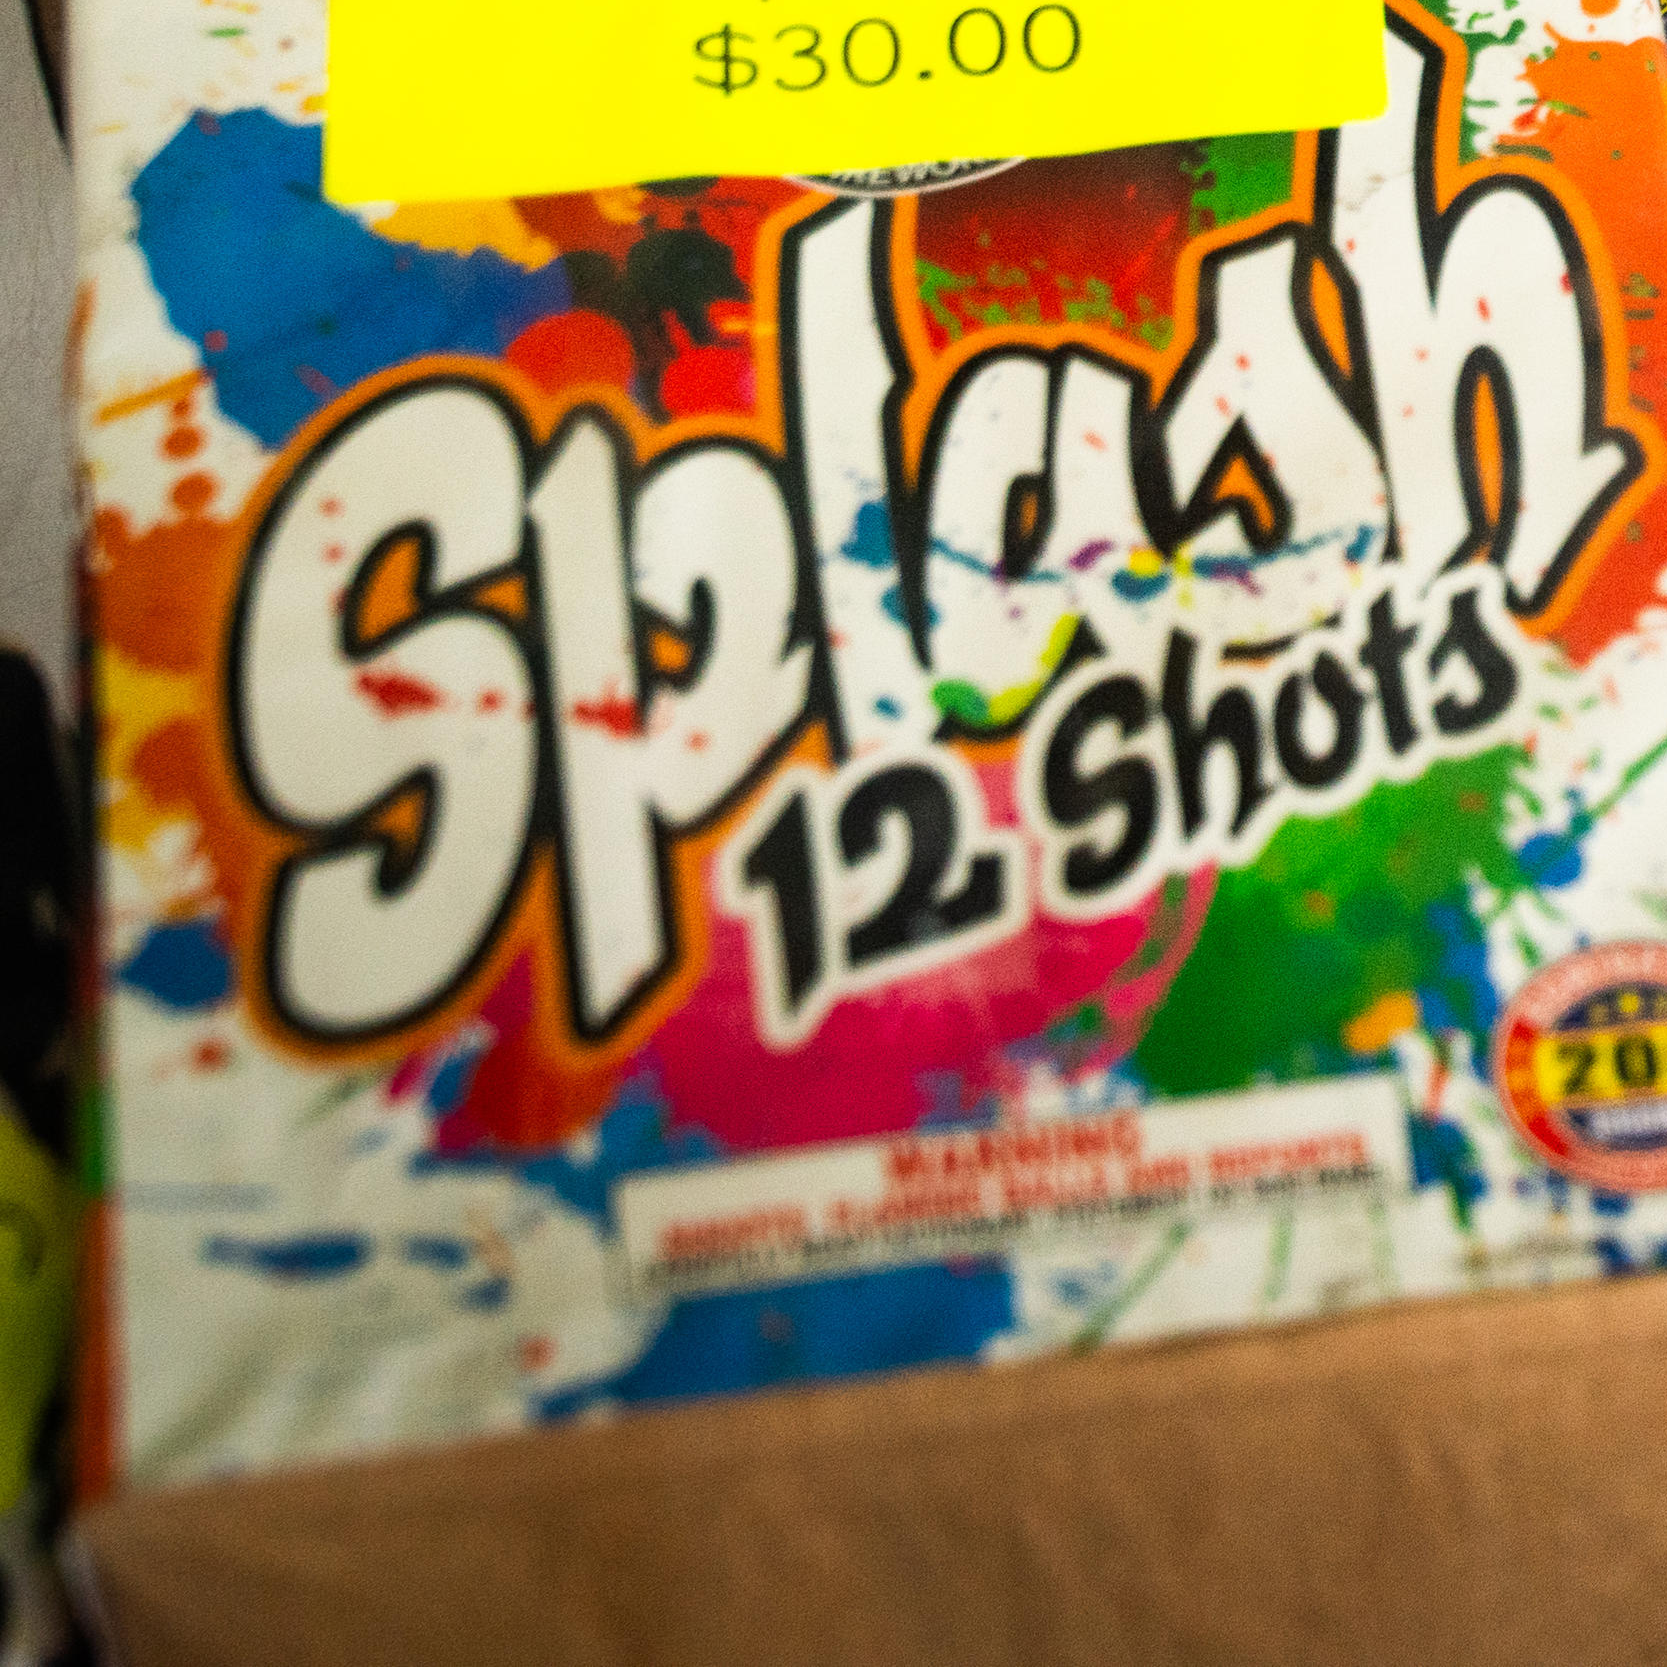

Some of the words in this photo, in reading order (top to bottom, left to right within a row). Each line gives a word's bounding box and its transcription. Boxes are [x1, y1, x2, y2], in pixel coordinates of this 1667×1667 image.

[693, 2, 1083, 97] $30.00
[227, 24, 1644, 1047] Splash
[742, 761, 1007, 1018] 12
[1041, 588, 1521, 896] Shots
